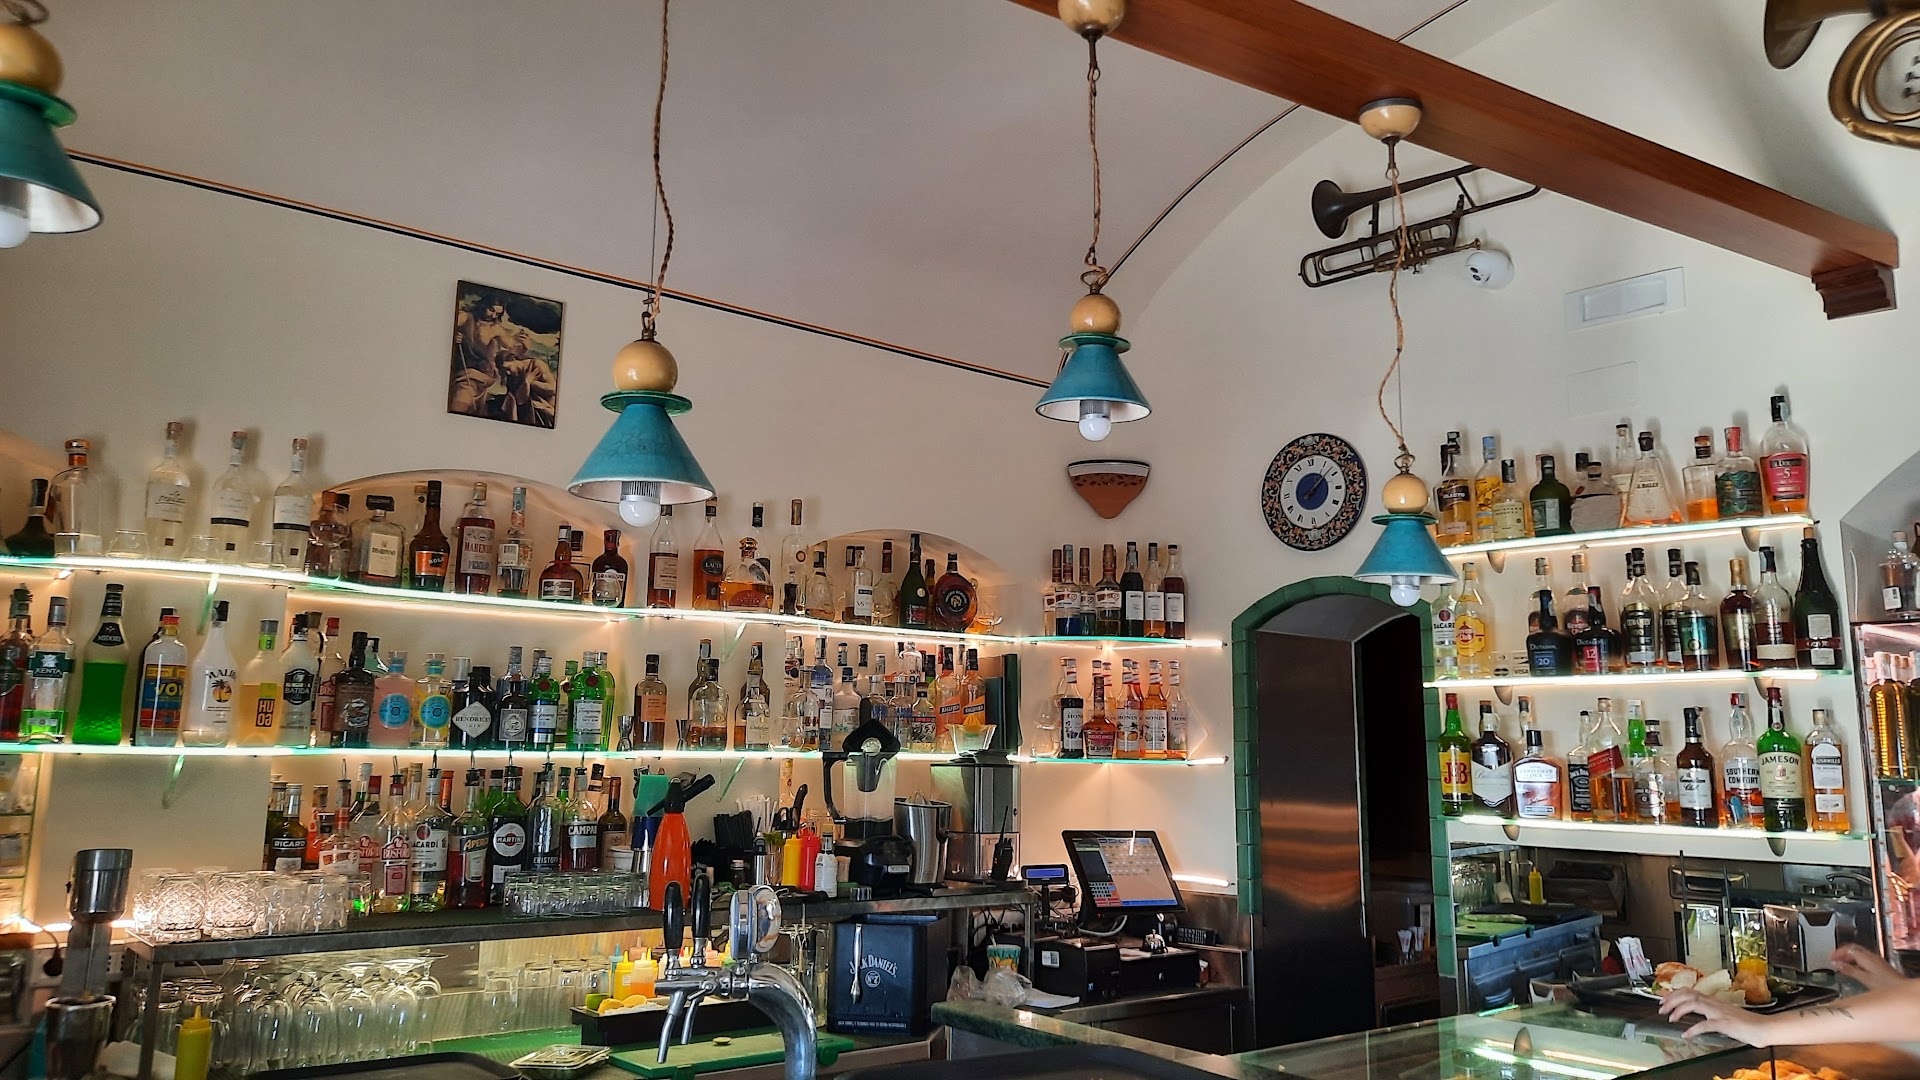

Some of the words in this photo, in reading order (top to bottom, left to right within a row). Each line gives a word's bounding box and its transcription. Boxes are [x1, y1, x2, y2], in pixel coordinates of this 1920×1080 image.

[1783, 468, 1791, 479] 5
[1586, 649, 1597, 659] 12
[1538, 658, 1550, 666] 20
[34, 667, 63, 676] XENTA
[1761, 756, 1799, 765] JAMESON
[568, 825, 598, 835] CAMPA
[274, 840, 306, 848] RICARD
[868, 954, 897, 976] DANIEL'S
